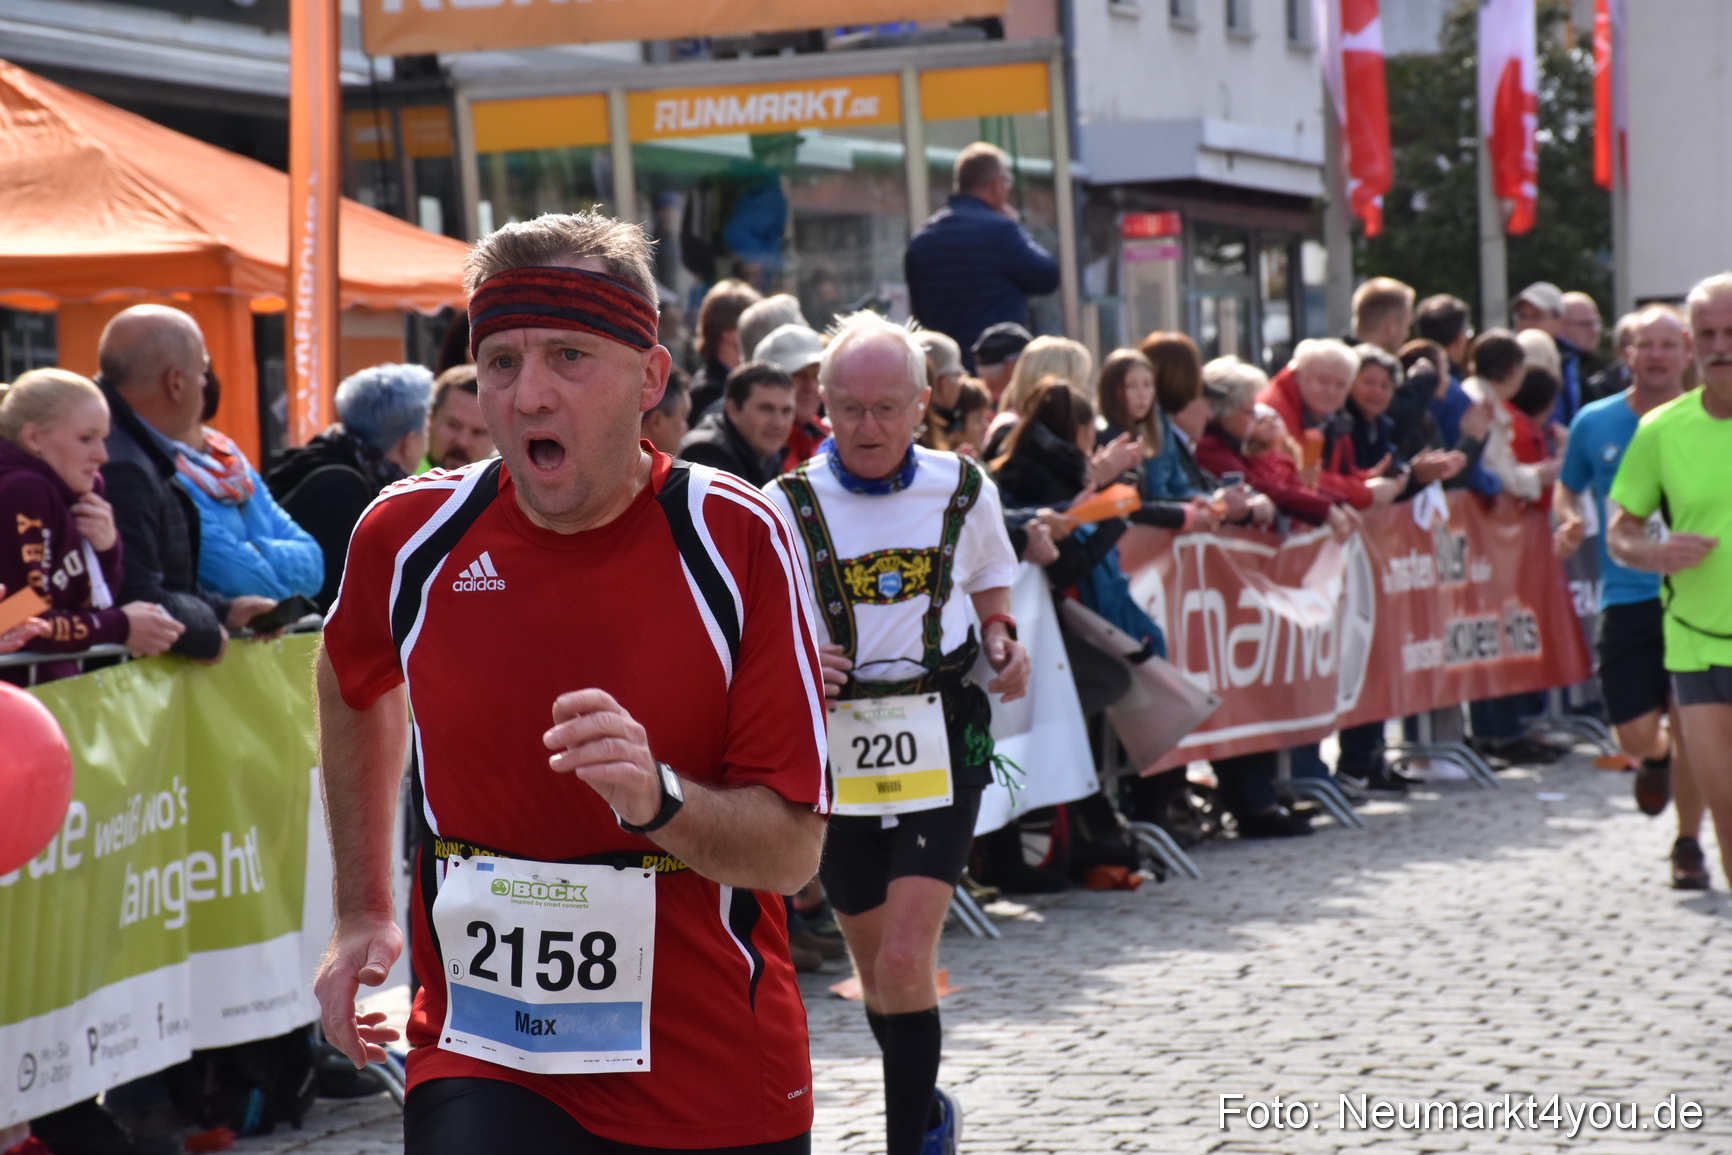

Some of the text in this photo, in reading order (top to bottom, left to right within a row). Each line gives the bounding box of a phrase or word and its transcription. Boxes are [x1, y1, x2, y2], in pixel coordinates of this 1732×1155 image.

[452, 576, 506, 592] adidas
[852, 731, 917, 769] 220
[876, 781, 902, 794] Willi
[512, 880, 588, 902] BOCK
[511, 899, 534, 907] inspired
[466, 920, 617, 991] 2158
[453, 963, 460, 975] D
[514, 1010, 557, 1036] Max
